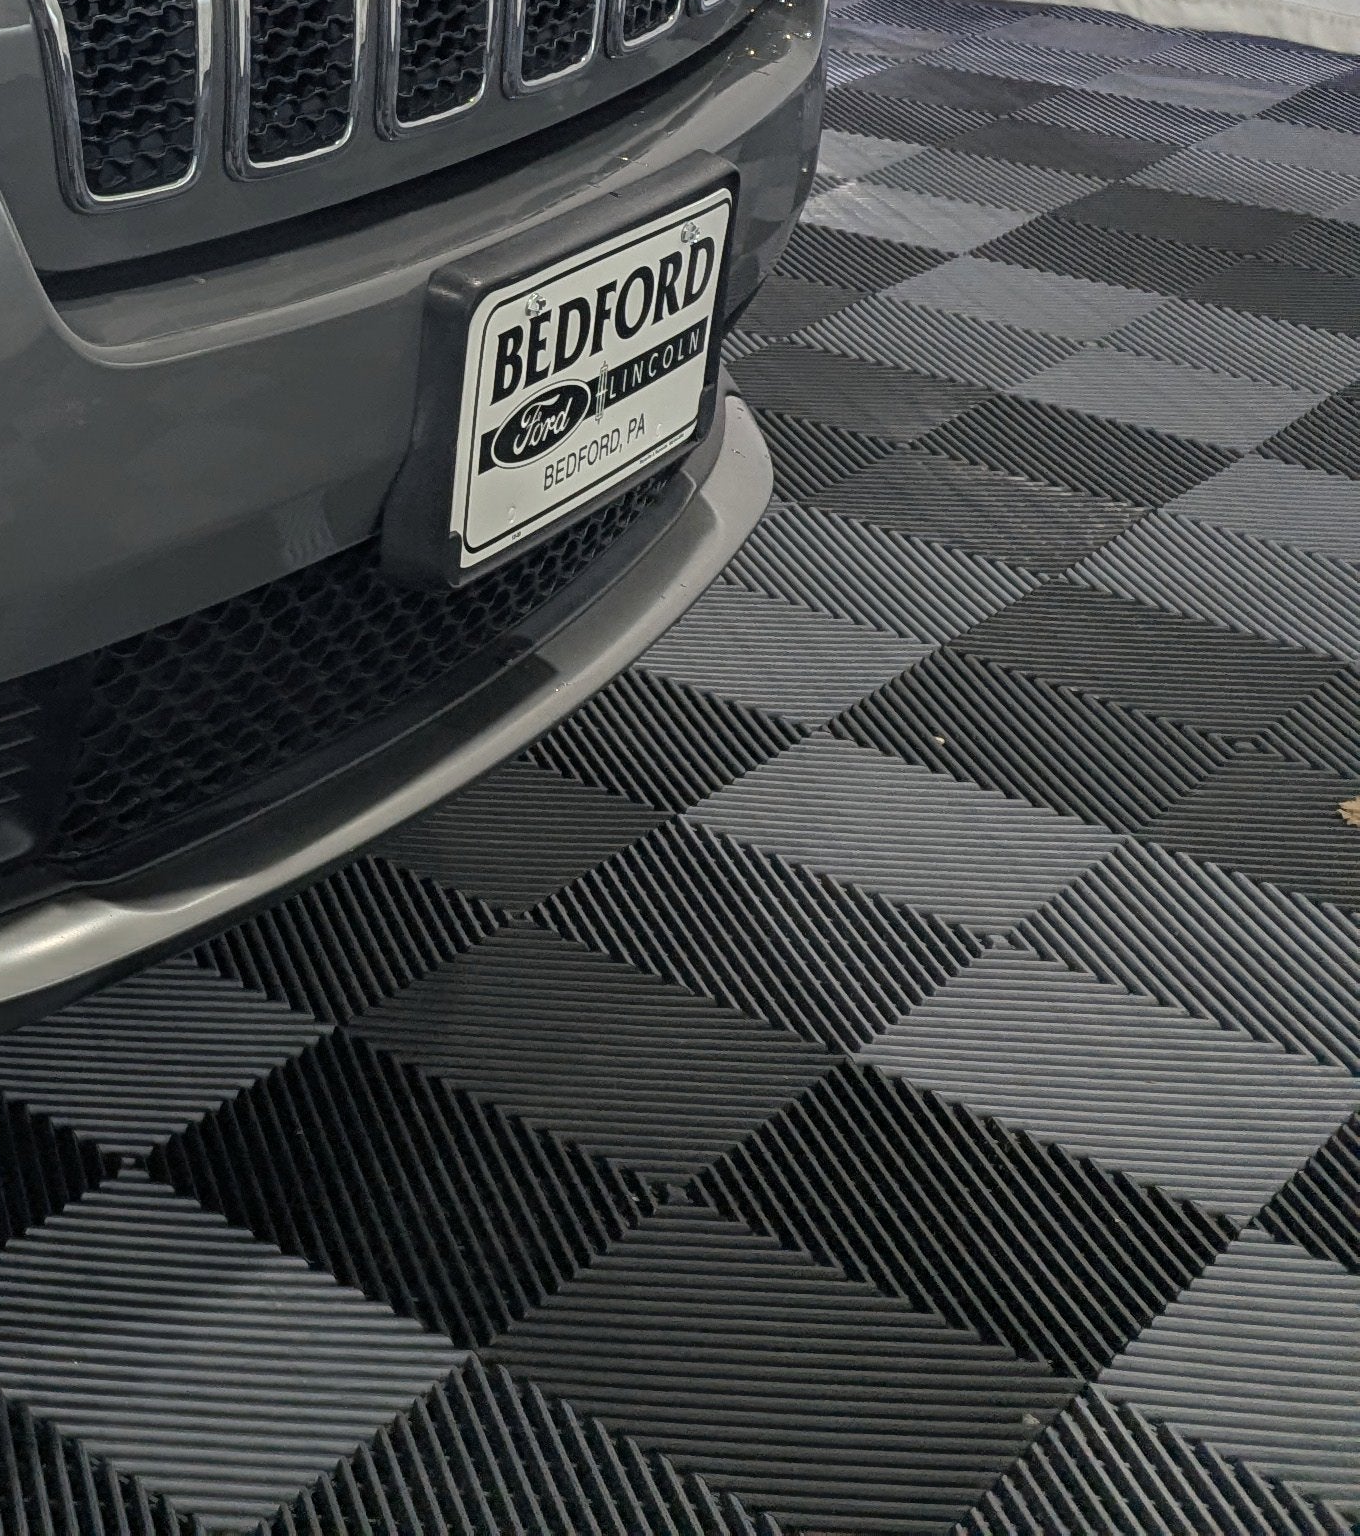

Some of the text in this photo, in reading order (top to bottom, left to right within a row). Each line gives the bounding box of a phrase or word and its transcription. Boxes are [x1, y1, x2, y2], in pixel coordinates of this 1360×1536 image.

[490, 236, 715, 406] BEDFORD
[513, 394, 573, 455] Ford
[609, 329, 699, 399] LINCOLN
[544, 428, 622, 490] BEDFORD,
[627, 413, 645, 444] PA
